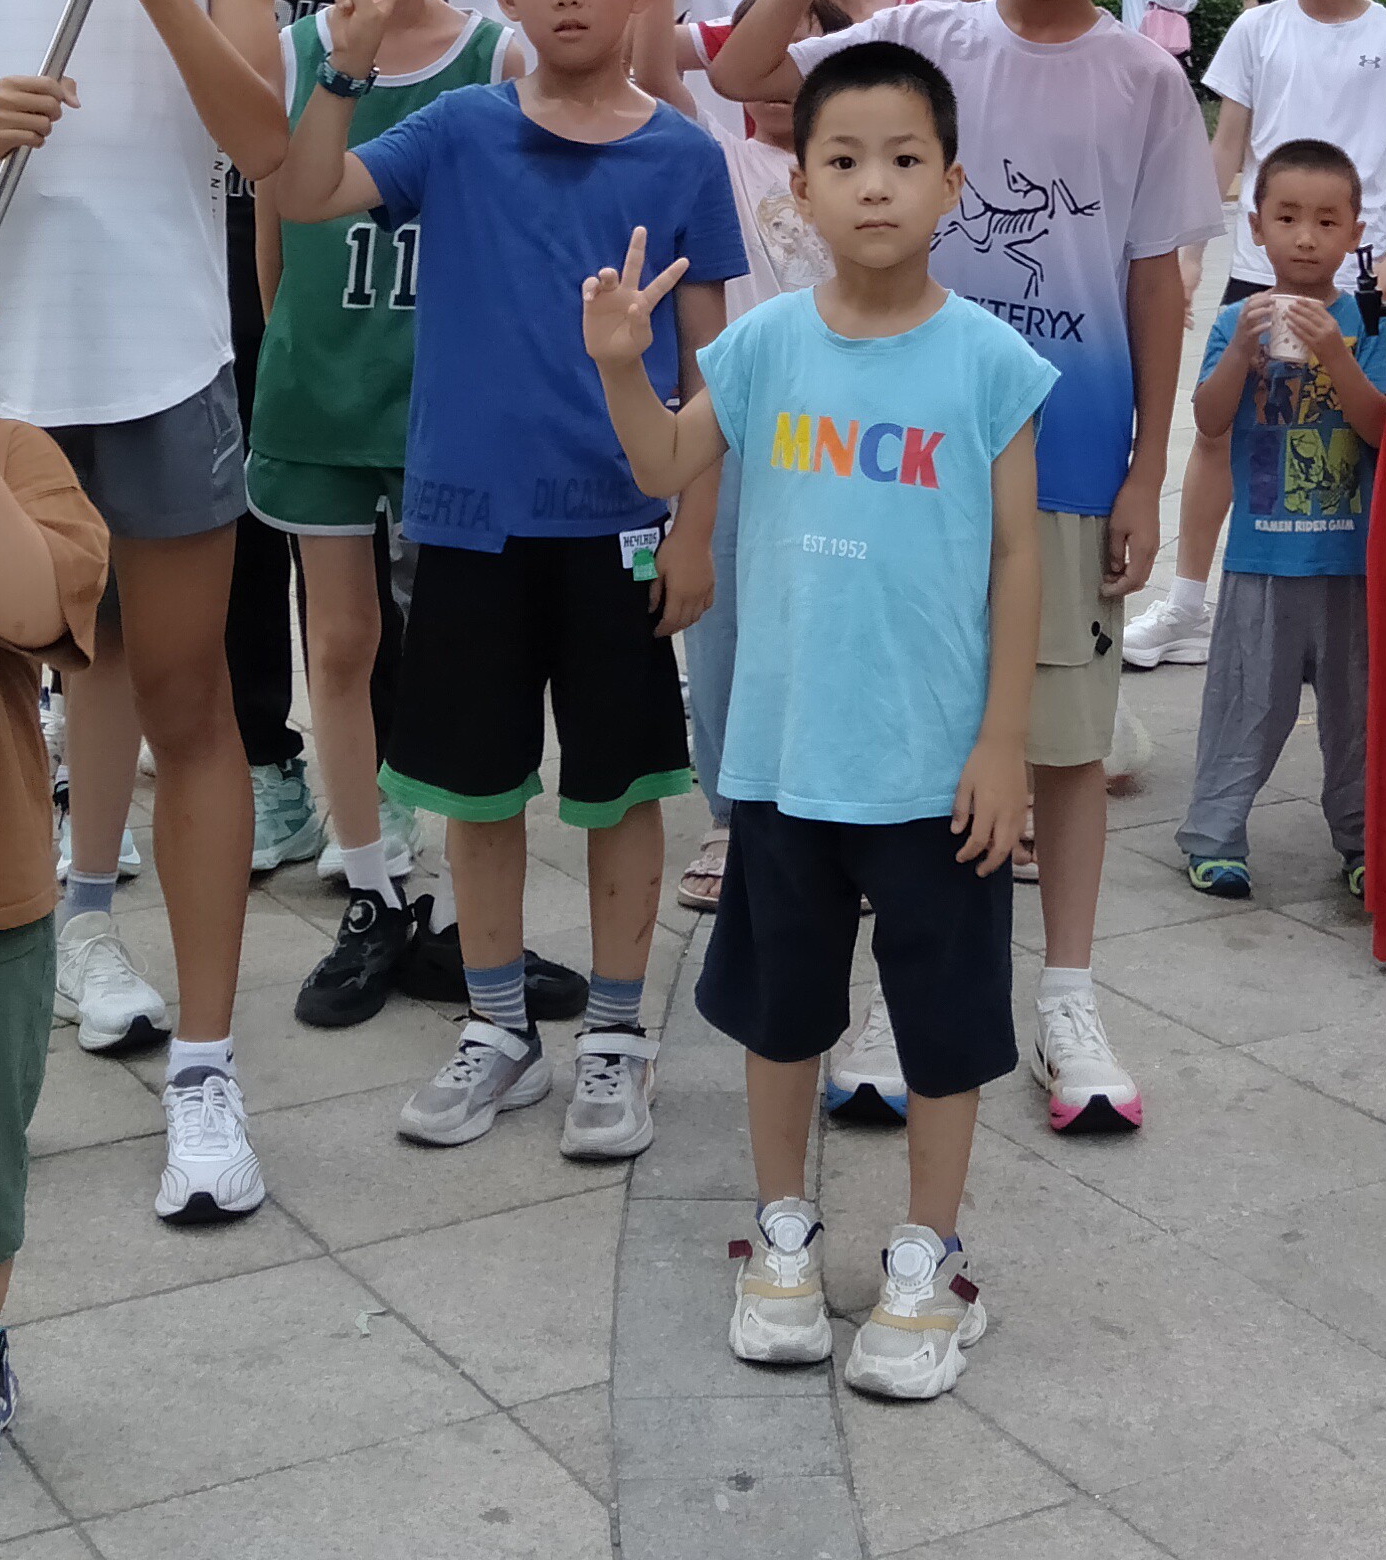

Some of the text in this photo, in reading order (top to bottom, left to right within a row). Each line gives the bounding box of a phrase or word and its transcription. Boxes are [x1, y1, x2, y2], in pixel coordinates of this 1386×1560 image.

[341, 222, 421, 310] 11
[770, 410, 947, 490] MNCK
[802, 533, 868, 561] EST.1952
[1294, 519, 1328, 533] RIDER
